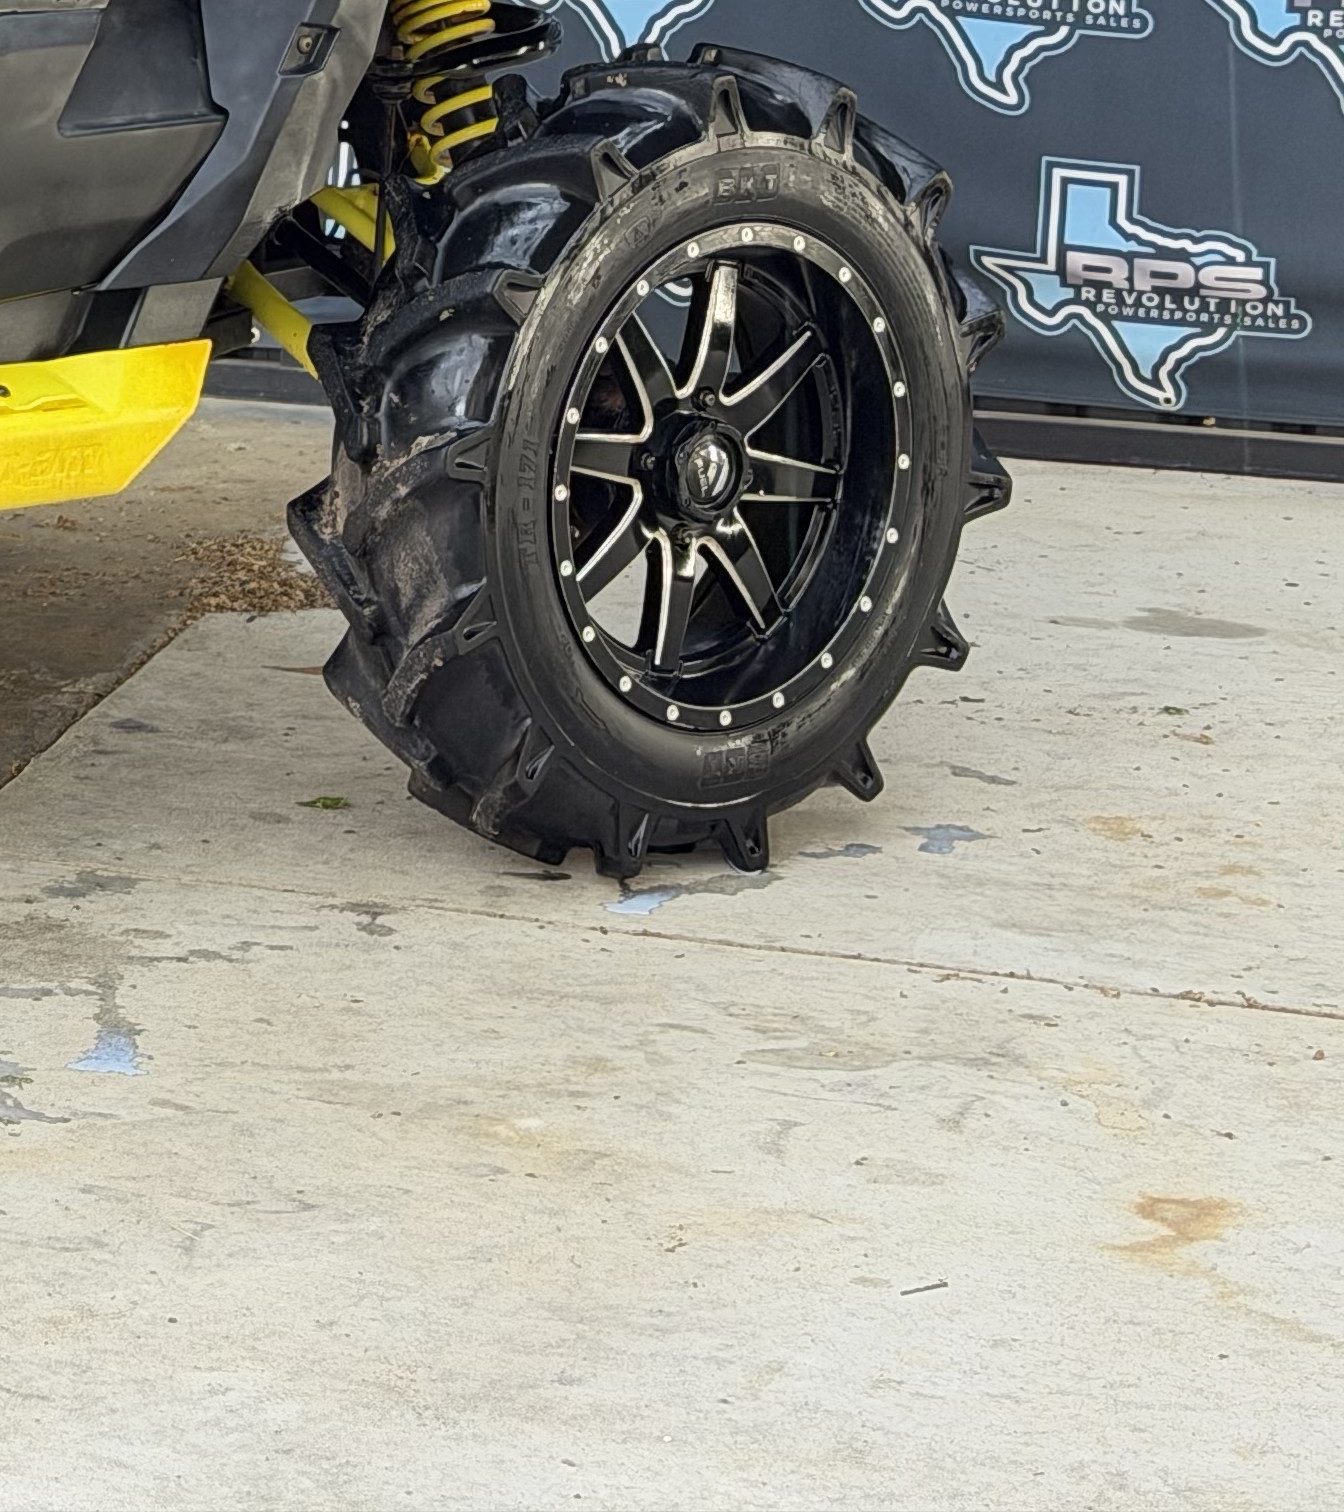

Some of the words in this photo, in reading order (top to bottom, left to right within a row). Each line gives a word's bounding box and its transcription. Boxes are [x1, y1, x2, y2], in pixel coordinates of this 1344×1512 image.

[1086, 15, 1141, 28] SALES
[716, 167, 779, 202] BKT
[1067, 251, 1267, 299] RPS
[1081, 287, 1284, 317] REVOLUTION
[1096, 303, 1232, 325] POWERSPORTS
[1244, 316, 1300, 329] SALES
